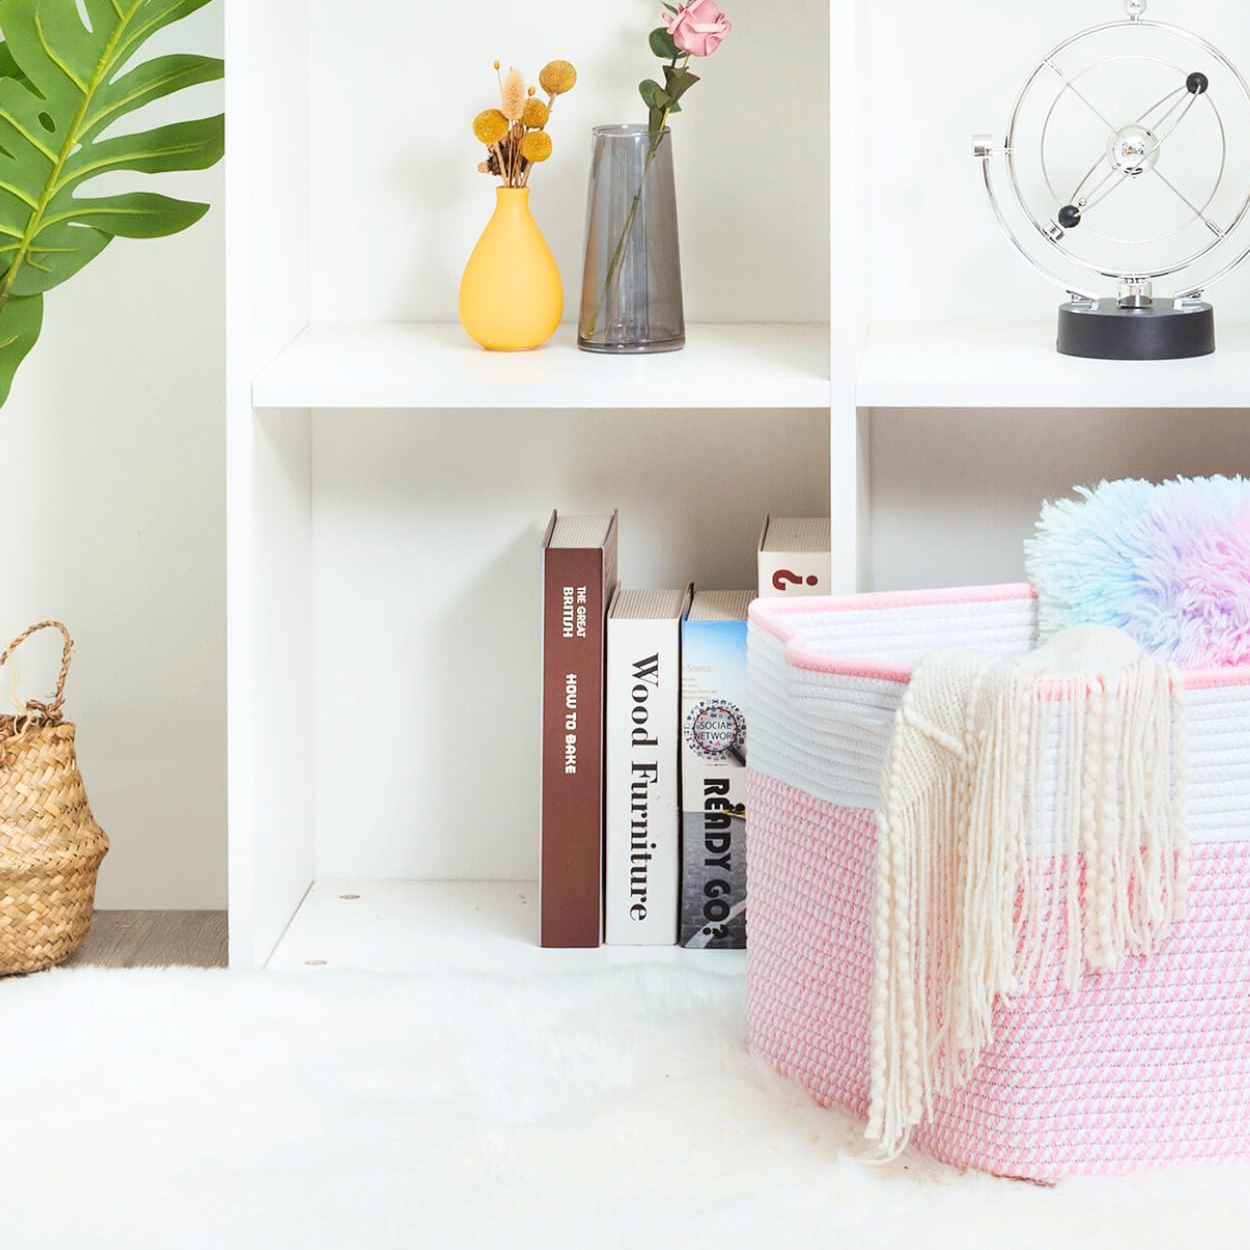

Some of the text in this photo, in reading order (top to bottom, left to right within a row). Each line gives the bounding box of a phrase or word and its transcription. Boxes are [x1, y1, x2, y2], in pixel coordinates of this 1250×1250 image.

[563, 587, 575, 637] BRITISH
[576, 586, 586, 637] THE GREAT
[564, 674, 576, 774] HOW TO BAKE
[700, 721, 732, 730] SOCIAL
[630, 654, 659, 921] Wood Furniture
[704, 778, 731, 871] READY
